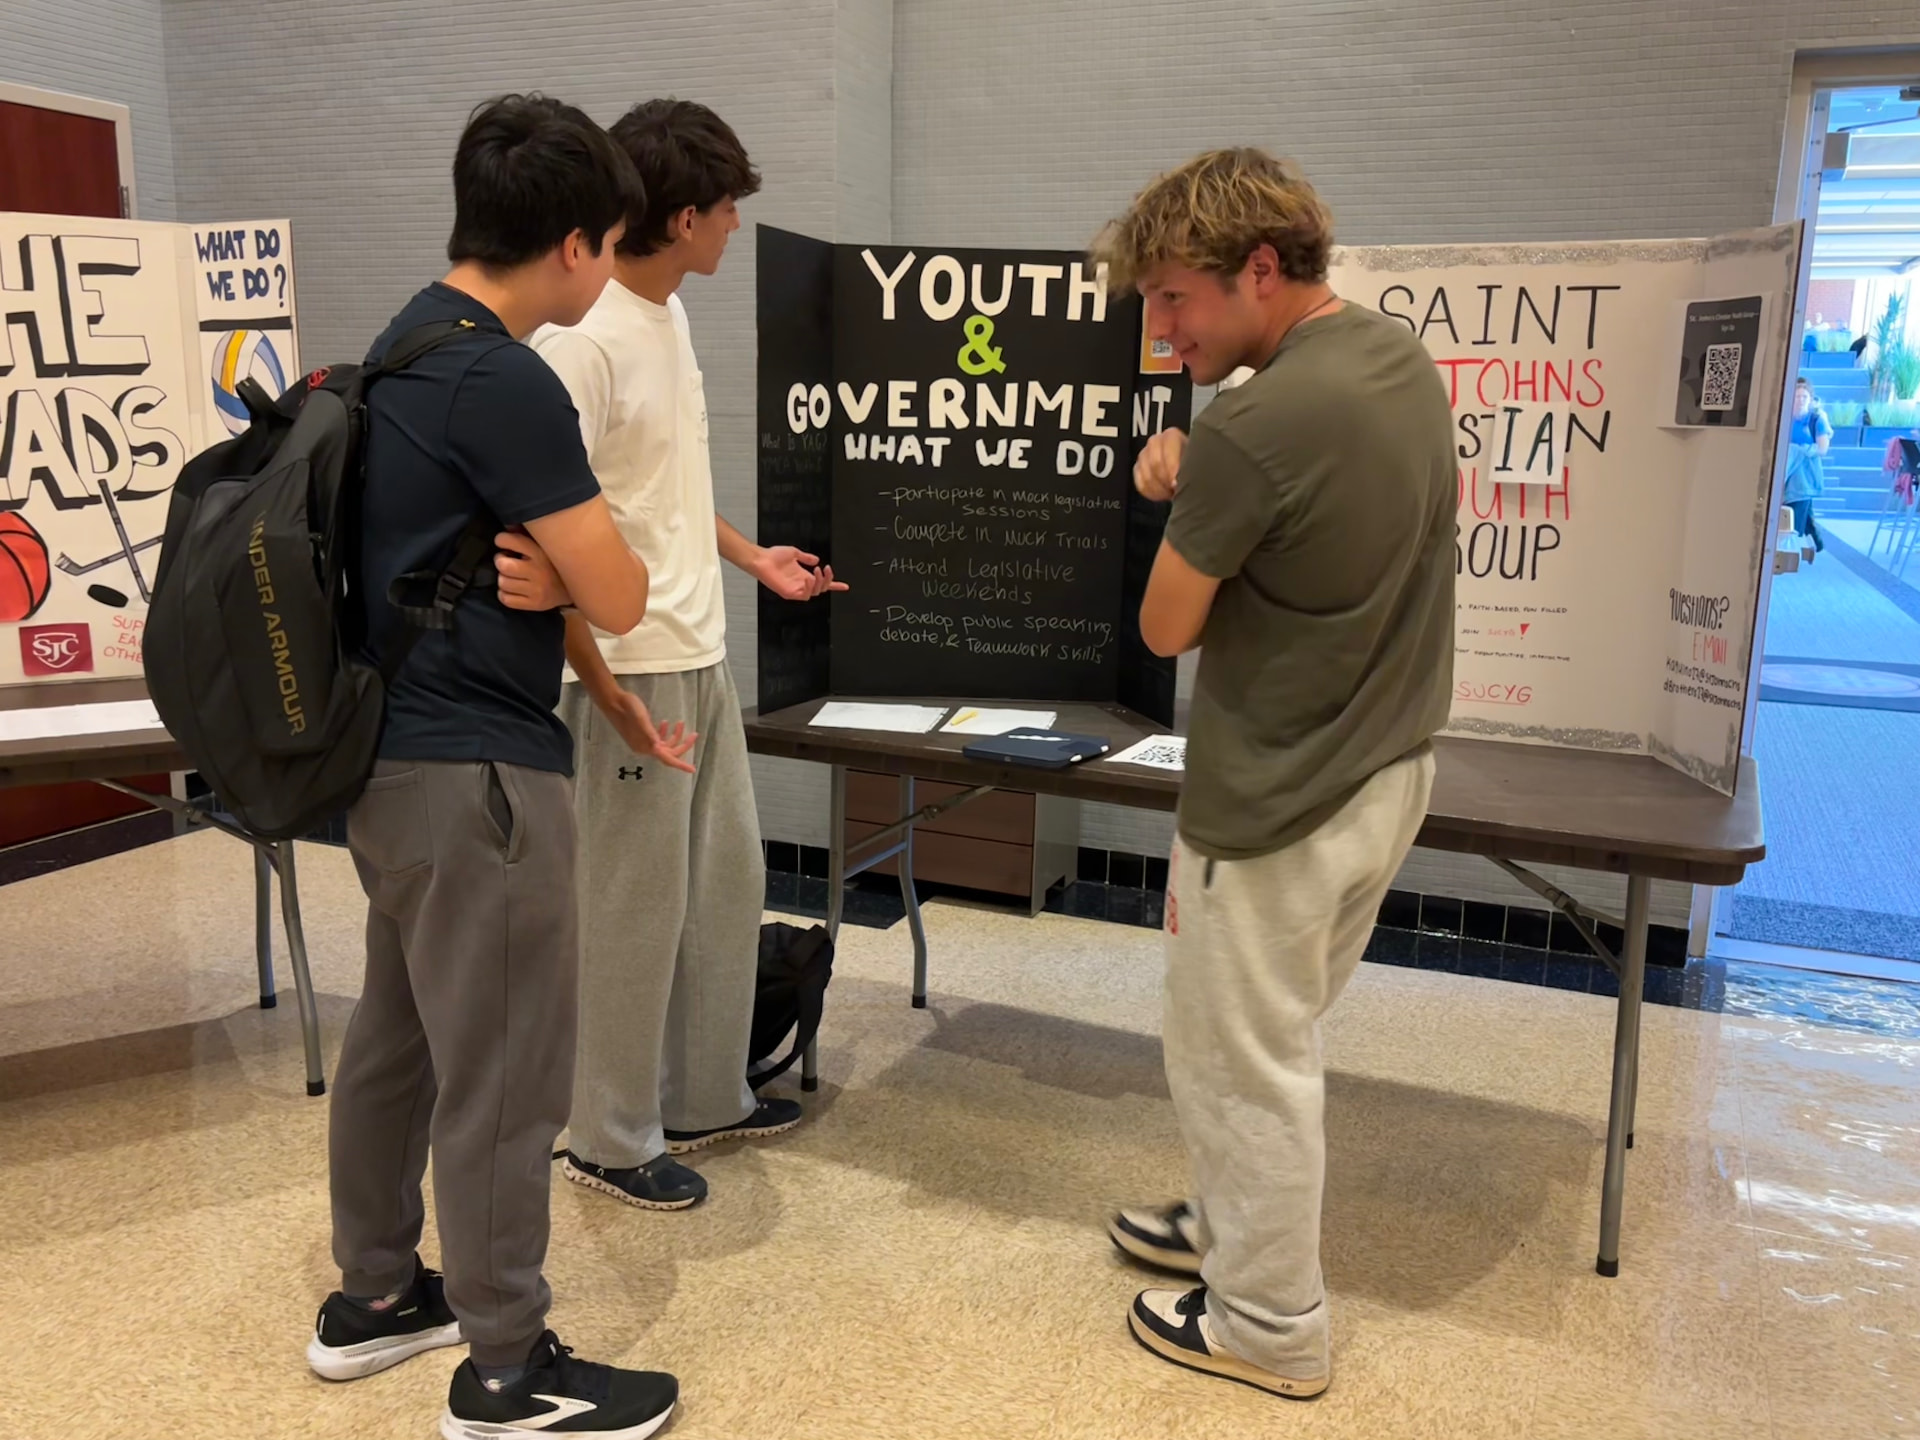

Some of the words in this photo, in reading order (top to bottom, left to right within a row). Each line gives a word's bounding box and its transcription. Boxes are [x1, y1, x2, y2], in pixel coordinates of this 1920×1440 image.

[195, 229, 247, 264] WHAT
[257, 229, 281, 259] DO
[207, 271, 236, 302] WE
[861, 249, 1110, 322] YOUTH
[1378, 284, 1622, 350] SAINT
[956, 314, 1007, 376] &
[1434, 357, 1605, 408] JOHNS
[0, 385, 186, 511] ADS
[844, 432, 951, 468] WHAT
[976, 437, 1033, 470] WE
[1056, 440, 1115, 479] DO
[894, 516, 968, 546] Compete
[1056, 531, 1108, 550] Trials
[888, 559, 948, 578] Attend
[968, 557, 1076, 588] Legislative
[922, 580, 1033, 605] Weekends
[113, 615, 144, 631] SUP
[248, 510, 276, 605] UNDER
[263, 611, 306, 738] ARMOUR
[886, 604, 954, 628] Develop
[962, 615, 1014, 635] public
[32, 638, 80, 662] SJC
[965, 637, 1049, 658] Teamwork
